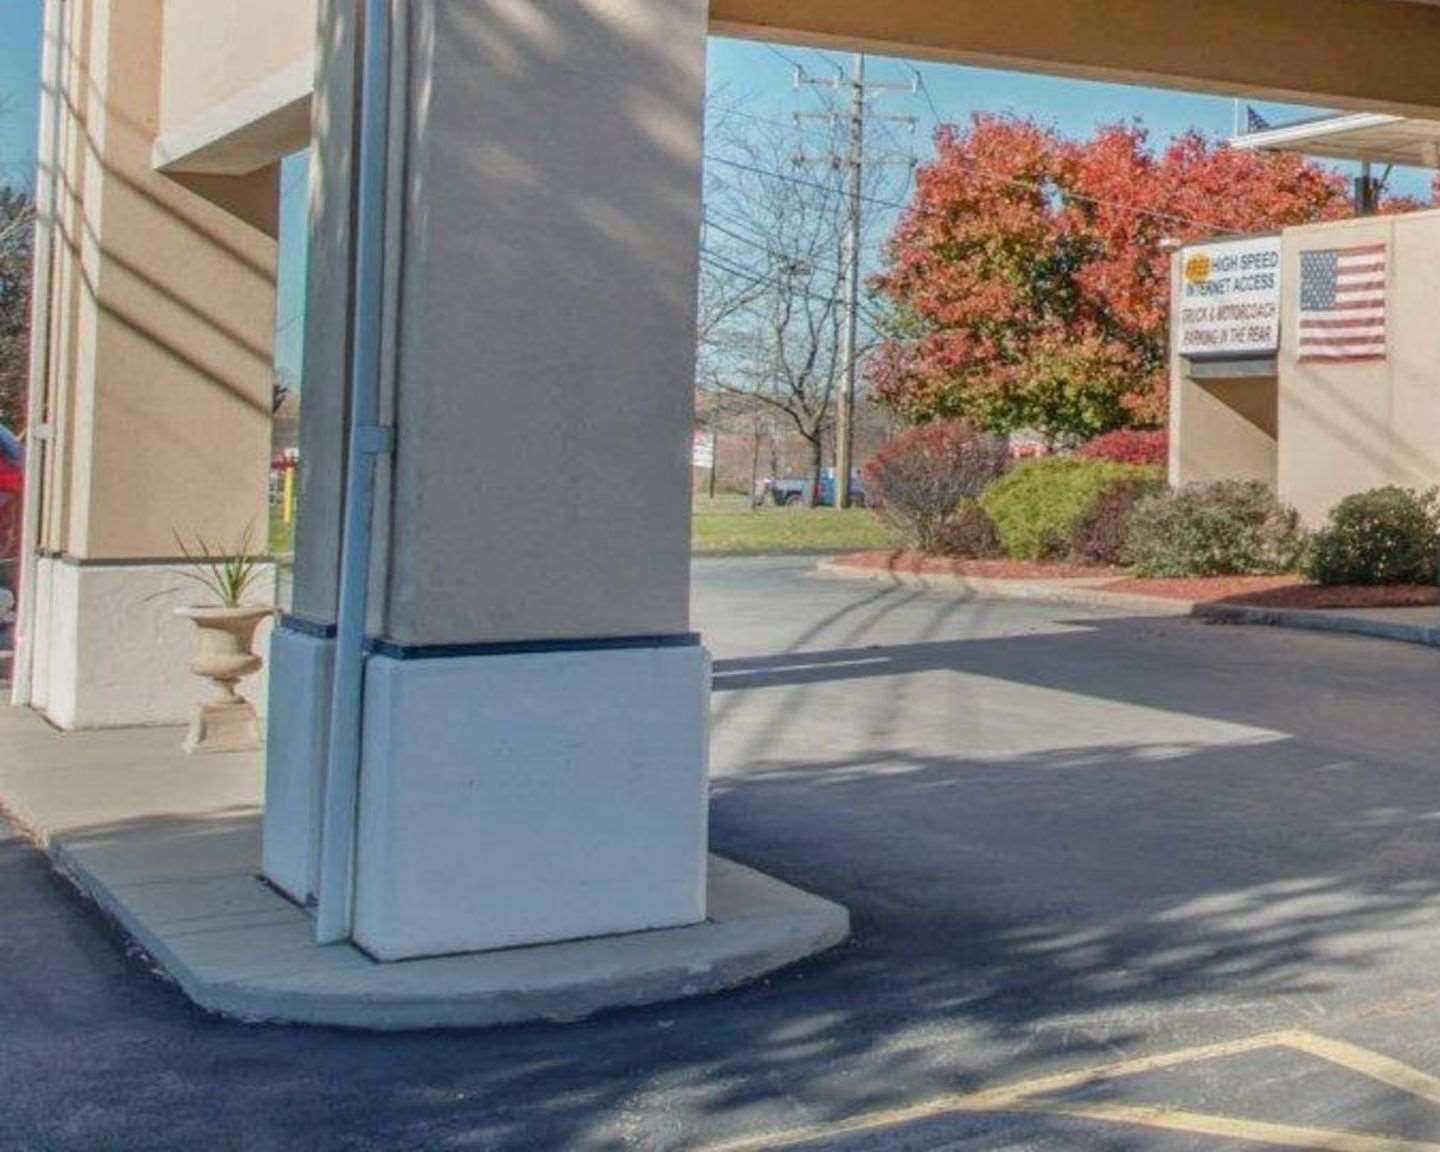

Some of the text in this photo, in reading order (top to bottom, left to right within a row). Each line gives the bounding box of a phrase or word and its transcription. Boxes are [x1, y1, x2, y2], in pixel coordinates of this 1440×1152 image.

[1211, 255, 1238, 272] HIGH
[1240, 250, 1279, 269] SPEED
[1186, 272, 1275, 296] INTERNET ACCESS
[1183, 306, 1207, 323] TRUCK
[1231, 326, 1247, 343] THE
[1248, 324, 1272, 342] REAR
